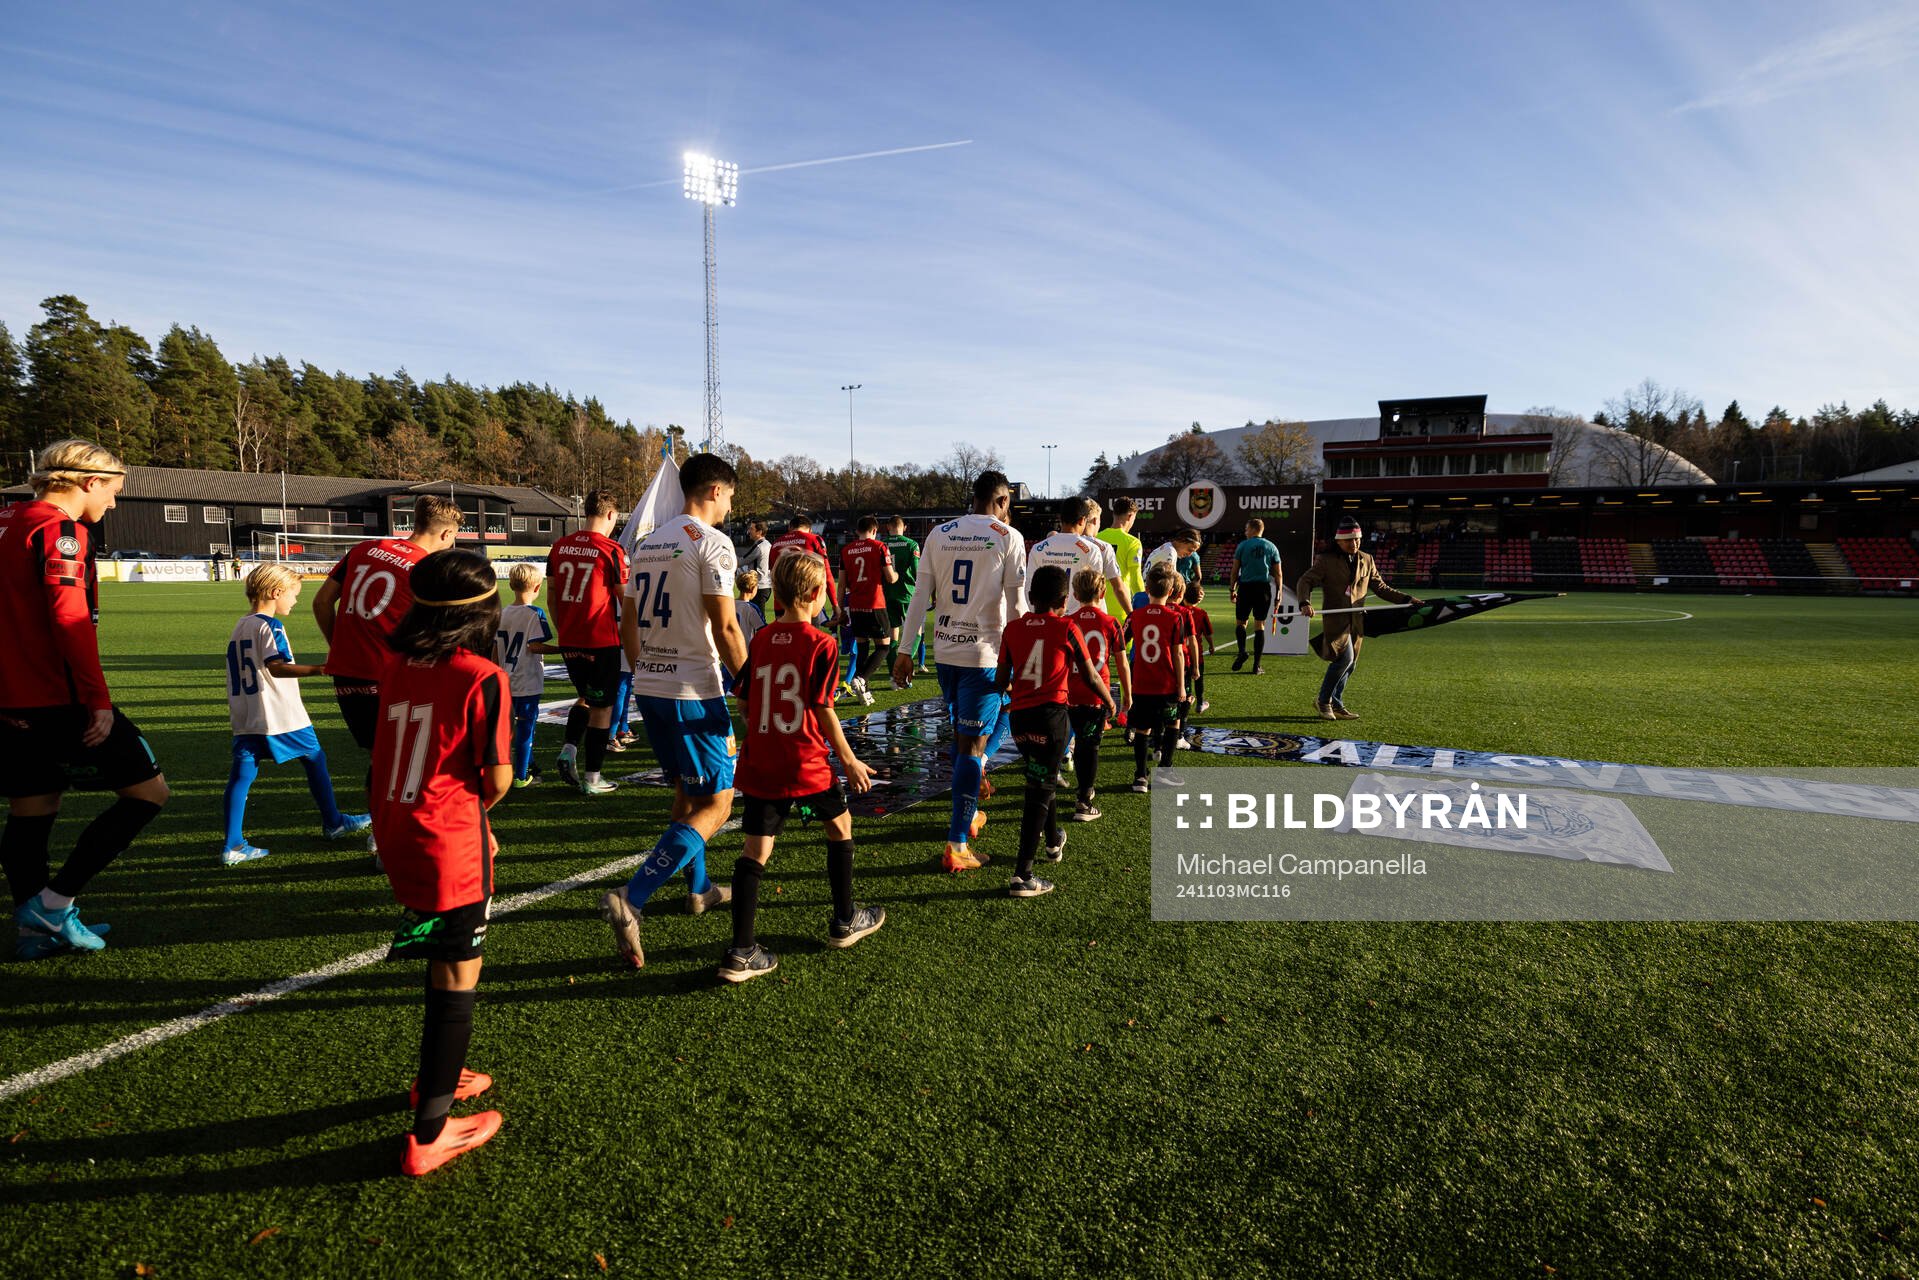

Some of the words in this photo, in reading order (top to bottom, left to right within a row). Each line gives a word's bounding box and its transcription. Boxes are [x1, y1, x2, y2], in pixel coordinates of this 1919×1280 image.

[1108, 497, 1165, 511] UBET
[1238, 495, 1302, 510] UNIBET
[367, 547, 415, 572] ODEFALK
[559, 545, 599, 558] BARSLUND
[847, 546, 872, 555] KARLSSON
[146, 563, 200, 575] weber
[559, 561, 595, 603] 27
[855, 557, 868, 582] 2
[951, 559, 973, 605] 9
[345, 564, 396, 620] 10
[635, 570, 672, 628] 24
[1278, 605, 1294, 625] U
[938, 631, 975, 644] RIMEDA
[1141, 624, 1161, 663] 8
[227, 639, 259, 697] 15
[1020, 639, 1045, 690] 4
[756, 663, 805, 734] 13
[387, 700, 433, 803] 11
